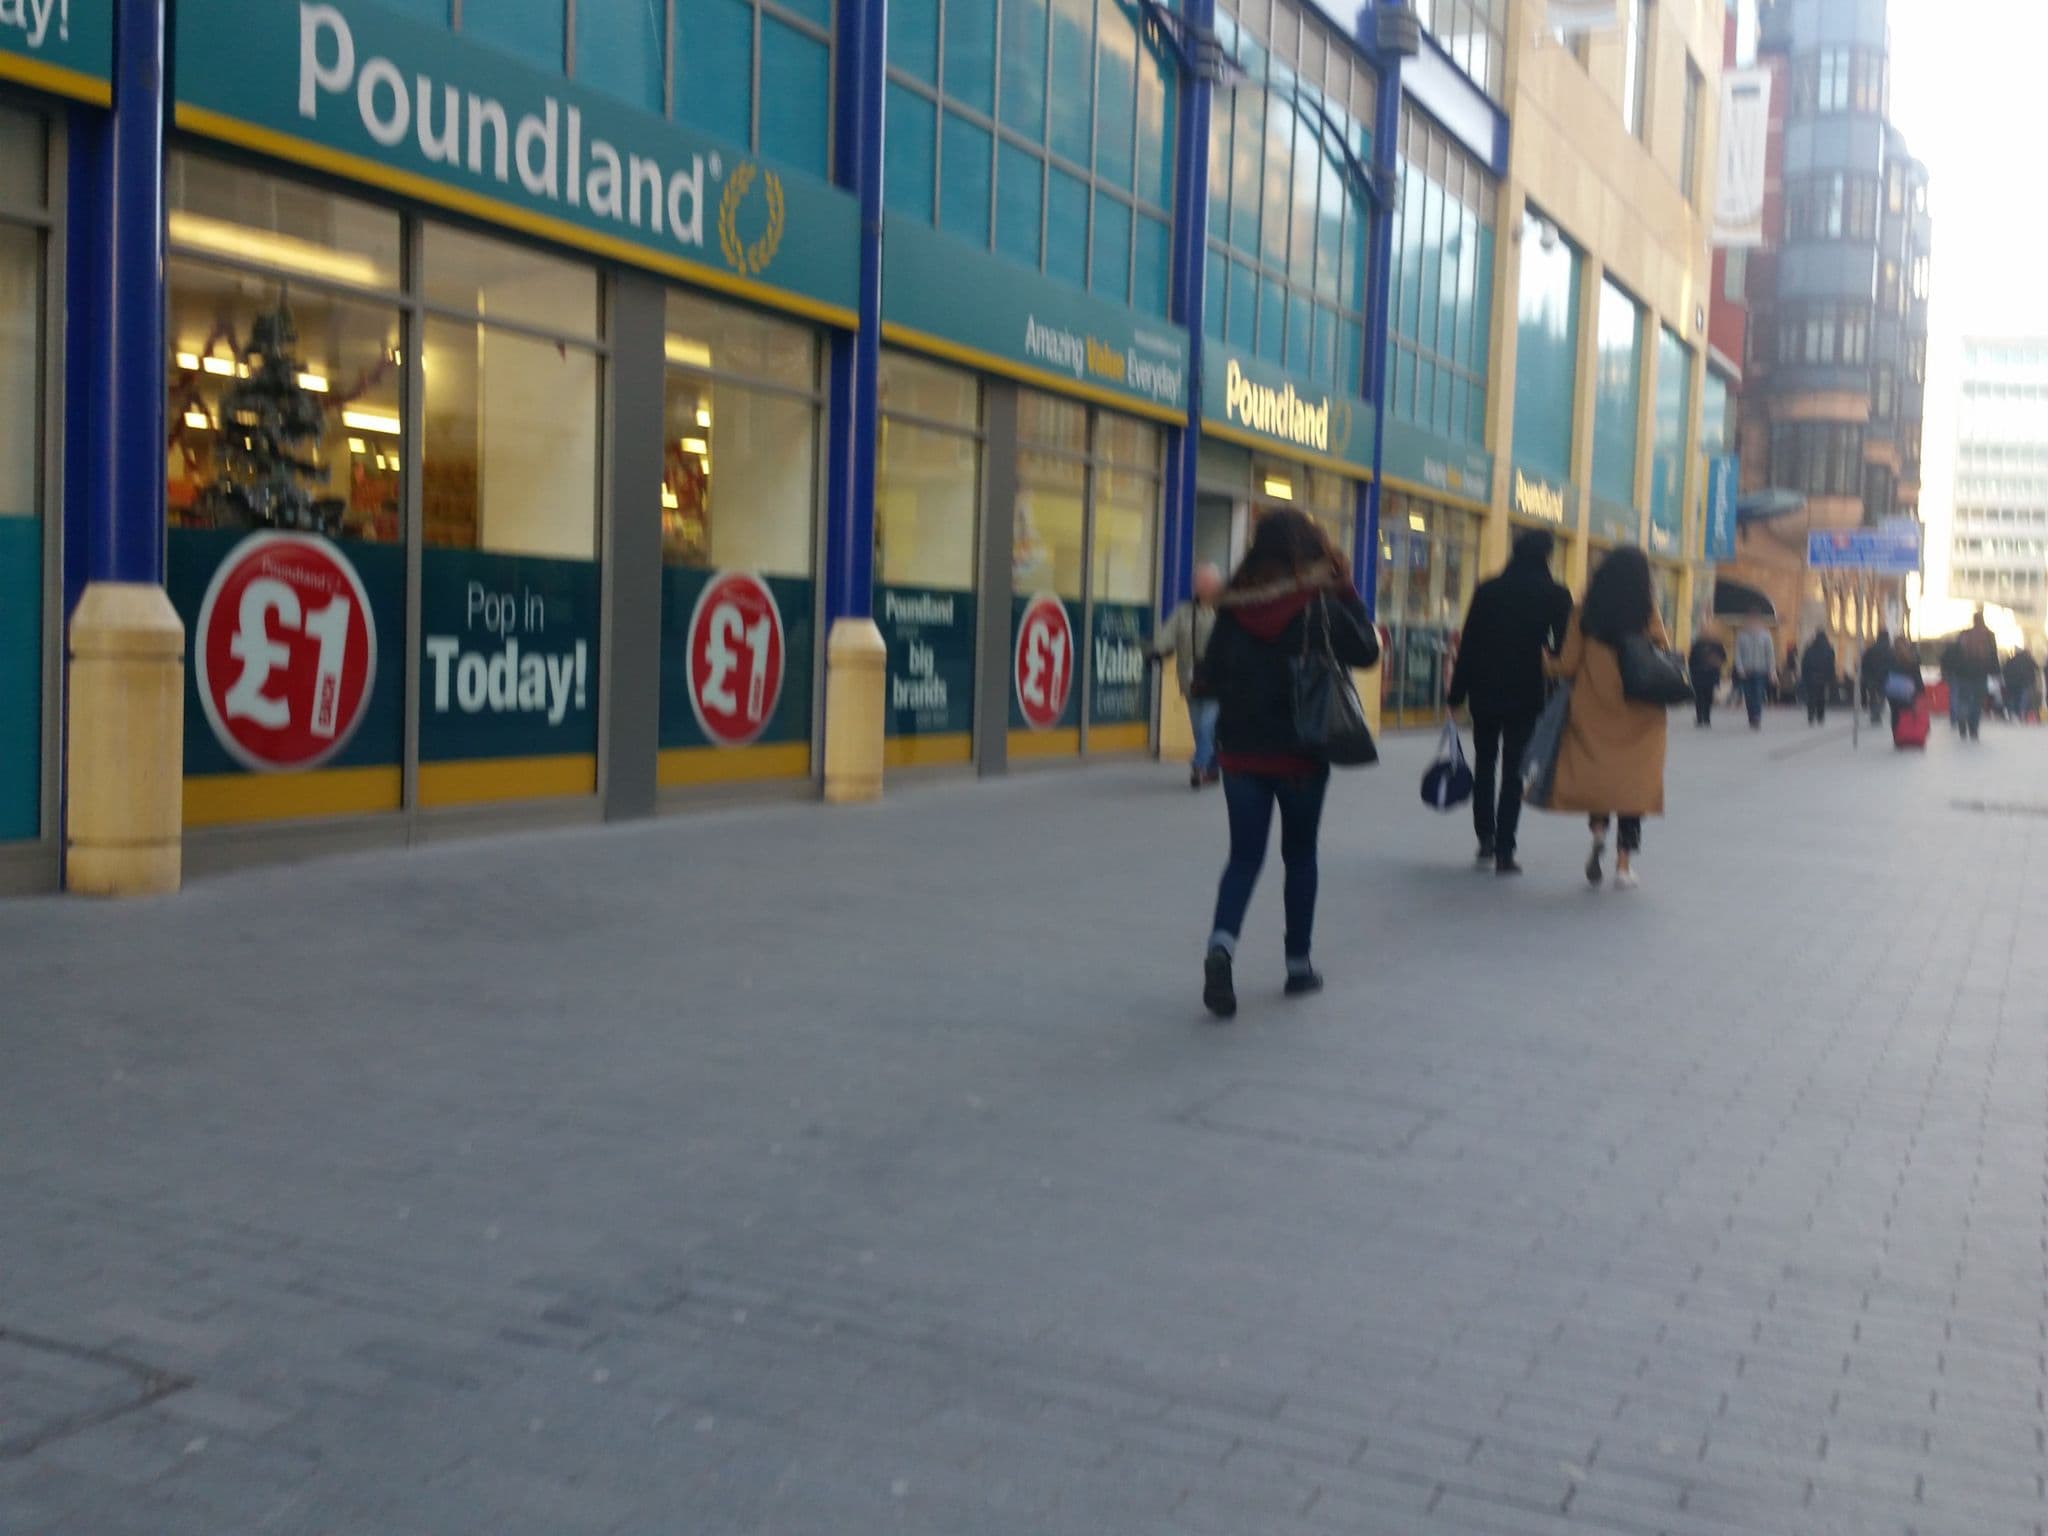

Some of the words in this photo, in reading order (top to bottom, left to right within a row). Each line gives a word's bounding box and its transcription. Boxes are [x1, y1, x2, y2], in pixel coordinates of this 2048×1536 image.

[299, 3, 704, 246] Poundland
[1226, 357, 1329, 451] Poundland
[468, 580, 516, 641] Pop
[225, 577, 350, 739] £1
[426, 634, 587, 726] Today!
[701, 603, 771, 721] £1
[1025, 621, 1064, 713] £1
[1095, 637, 1143, 684] Value
